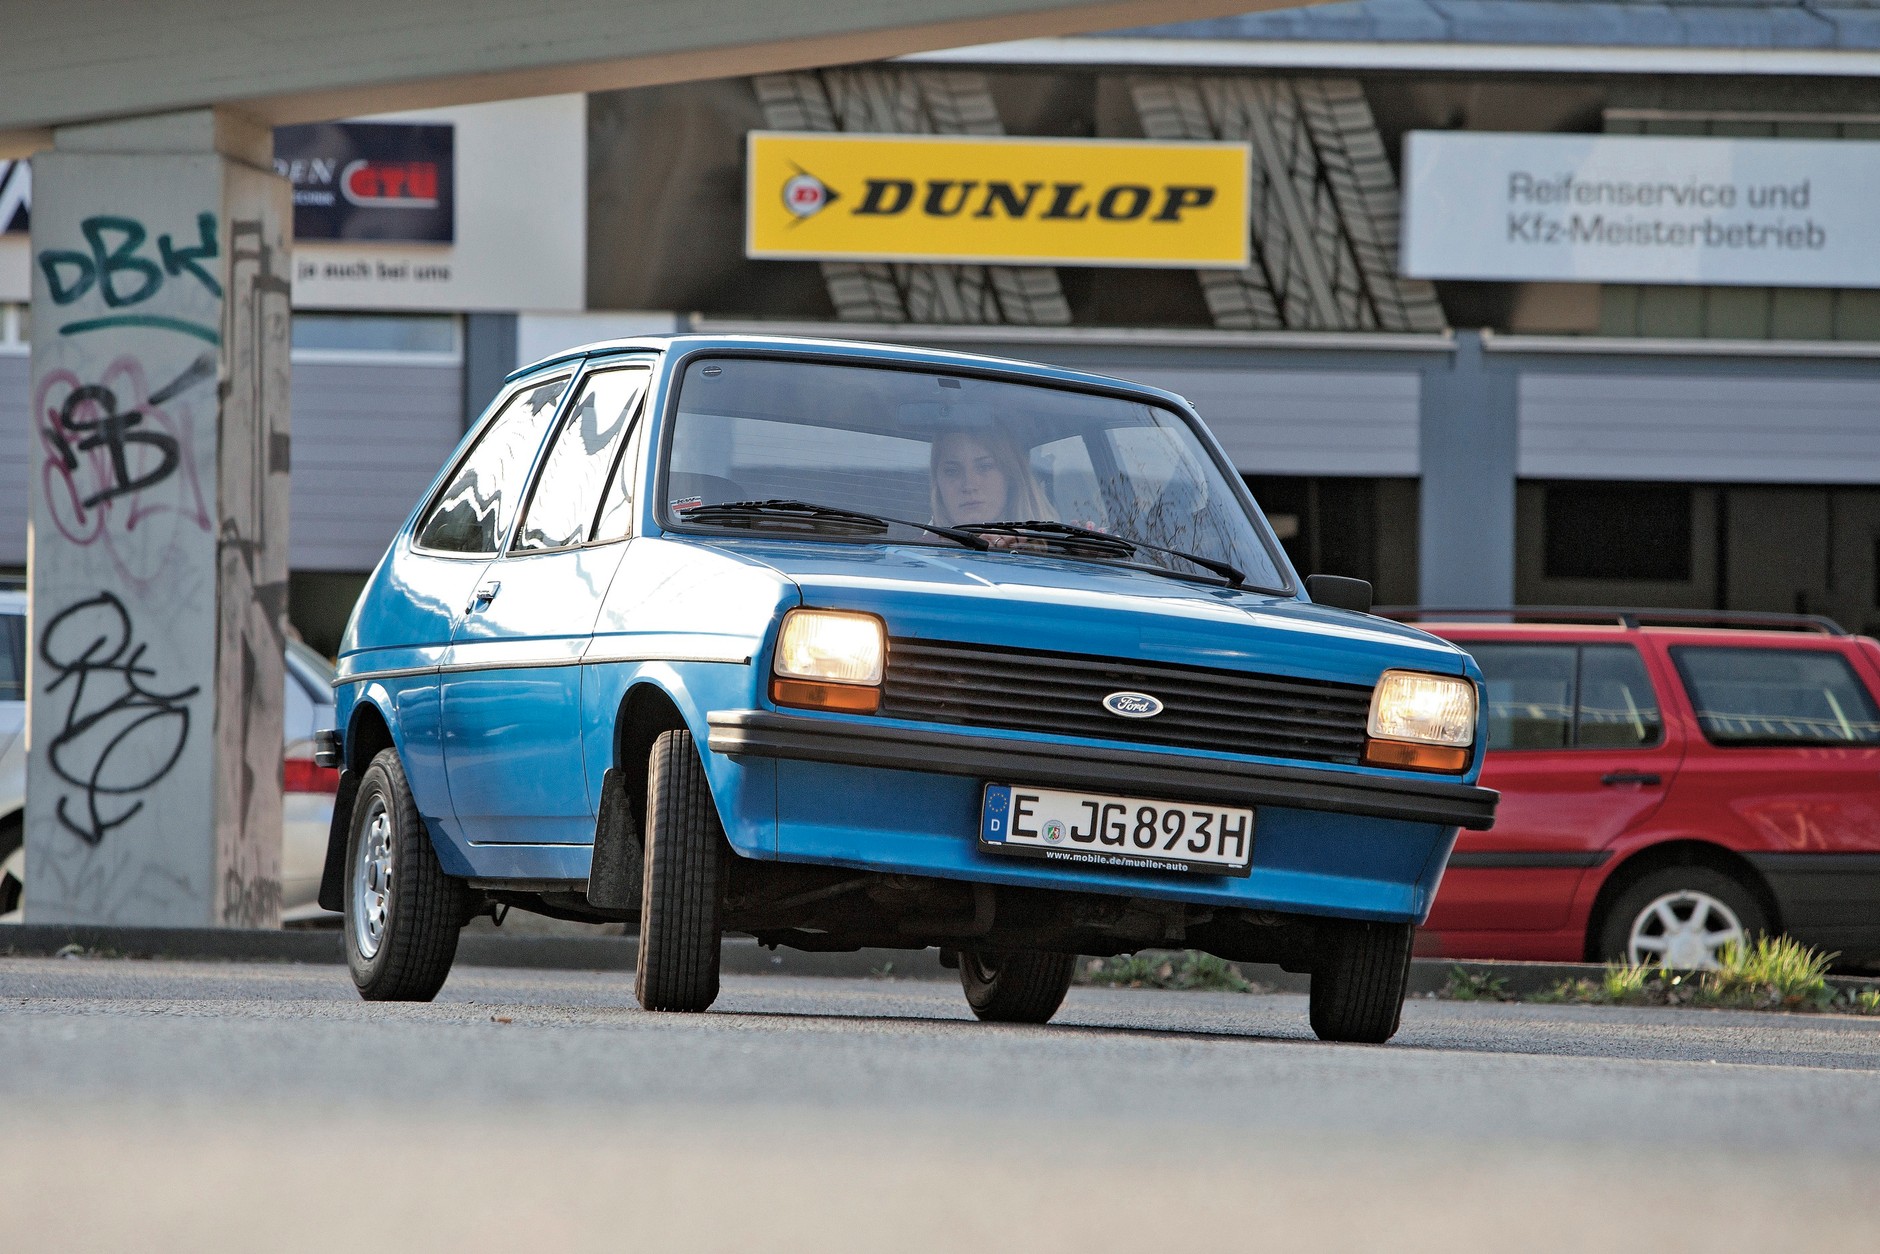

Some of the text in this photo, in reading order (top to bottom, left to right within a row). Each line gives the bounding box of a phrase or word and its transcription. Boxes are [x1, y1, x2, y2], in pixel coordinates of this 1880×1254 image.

[852, 178, 1217, 223] DUNLOP
[1508, 172, 1811, 209] Reifenservice und
[1508, 212, 1826, 249] Kfz-Meisterbetrieb
[1117, 696, 1149, 712] Ford
[990, 818, 1001, 831] D
[1011, 794, 1040, 838] E
